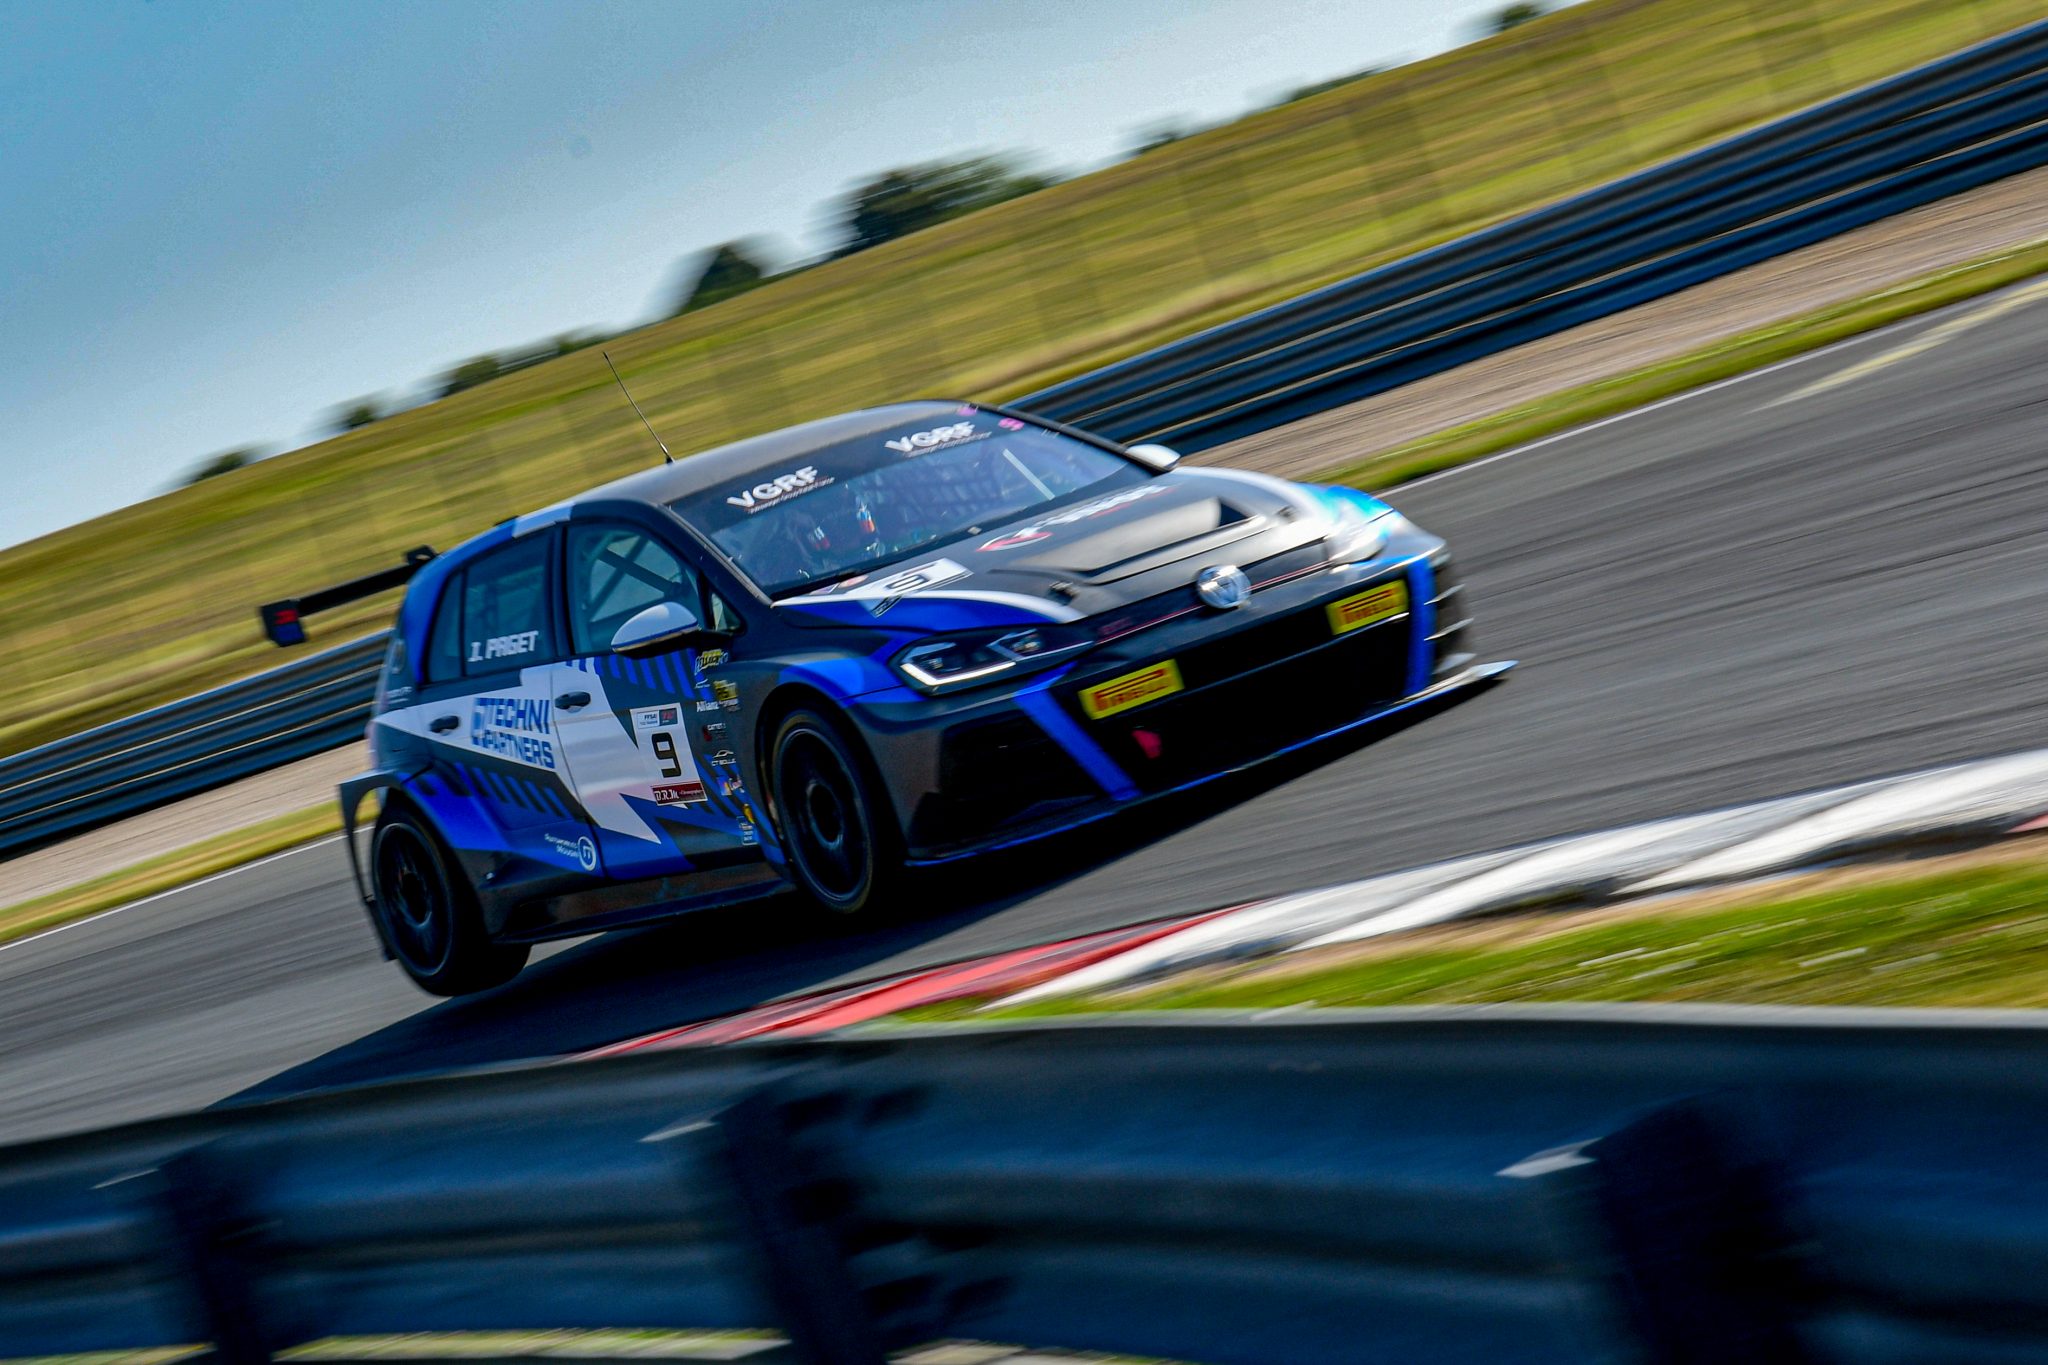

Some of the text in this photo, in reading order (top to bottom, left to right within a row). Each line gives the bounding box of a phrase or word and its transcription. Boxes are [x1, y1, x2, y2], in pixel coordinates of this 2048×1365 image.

[727, 465, 818, 507] VGRF
[484, 630, 539, 659] PAGET
[696, 700, 720, 713] Allianz
[1093, 666, 1174, 711] PIRELLI
[483, 697, 550, 735] TECHNI
[482, 729, 556, 769] PARTNERS
[651, 732, 682, 778] 9
